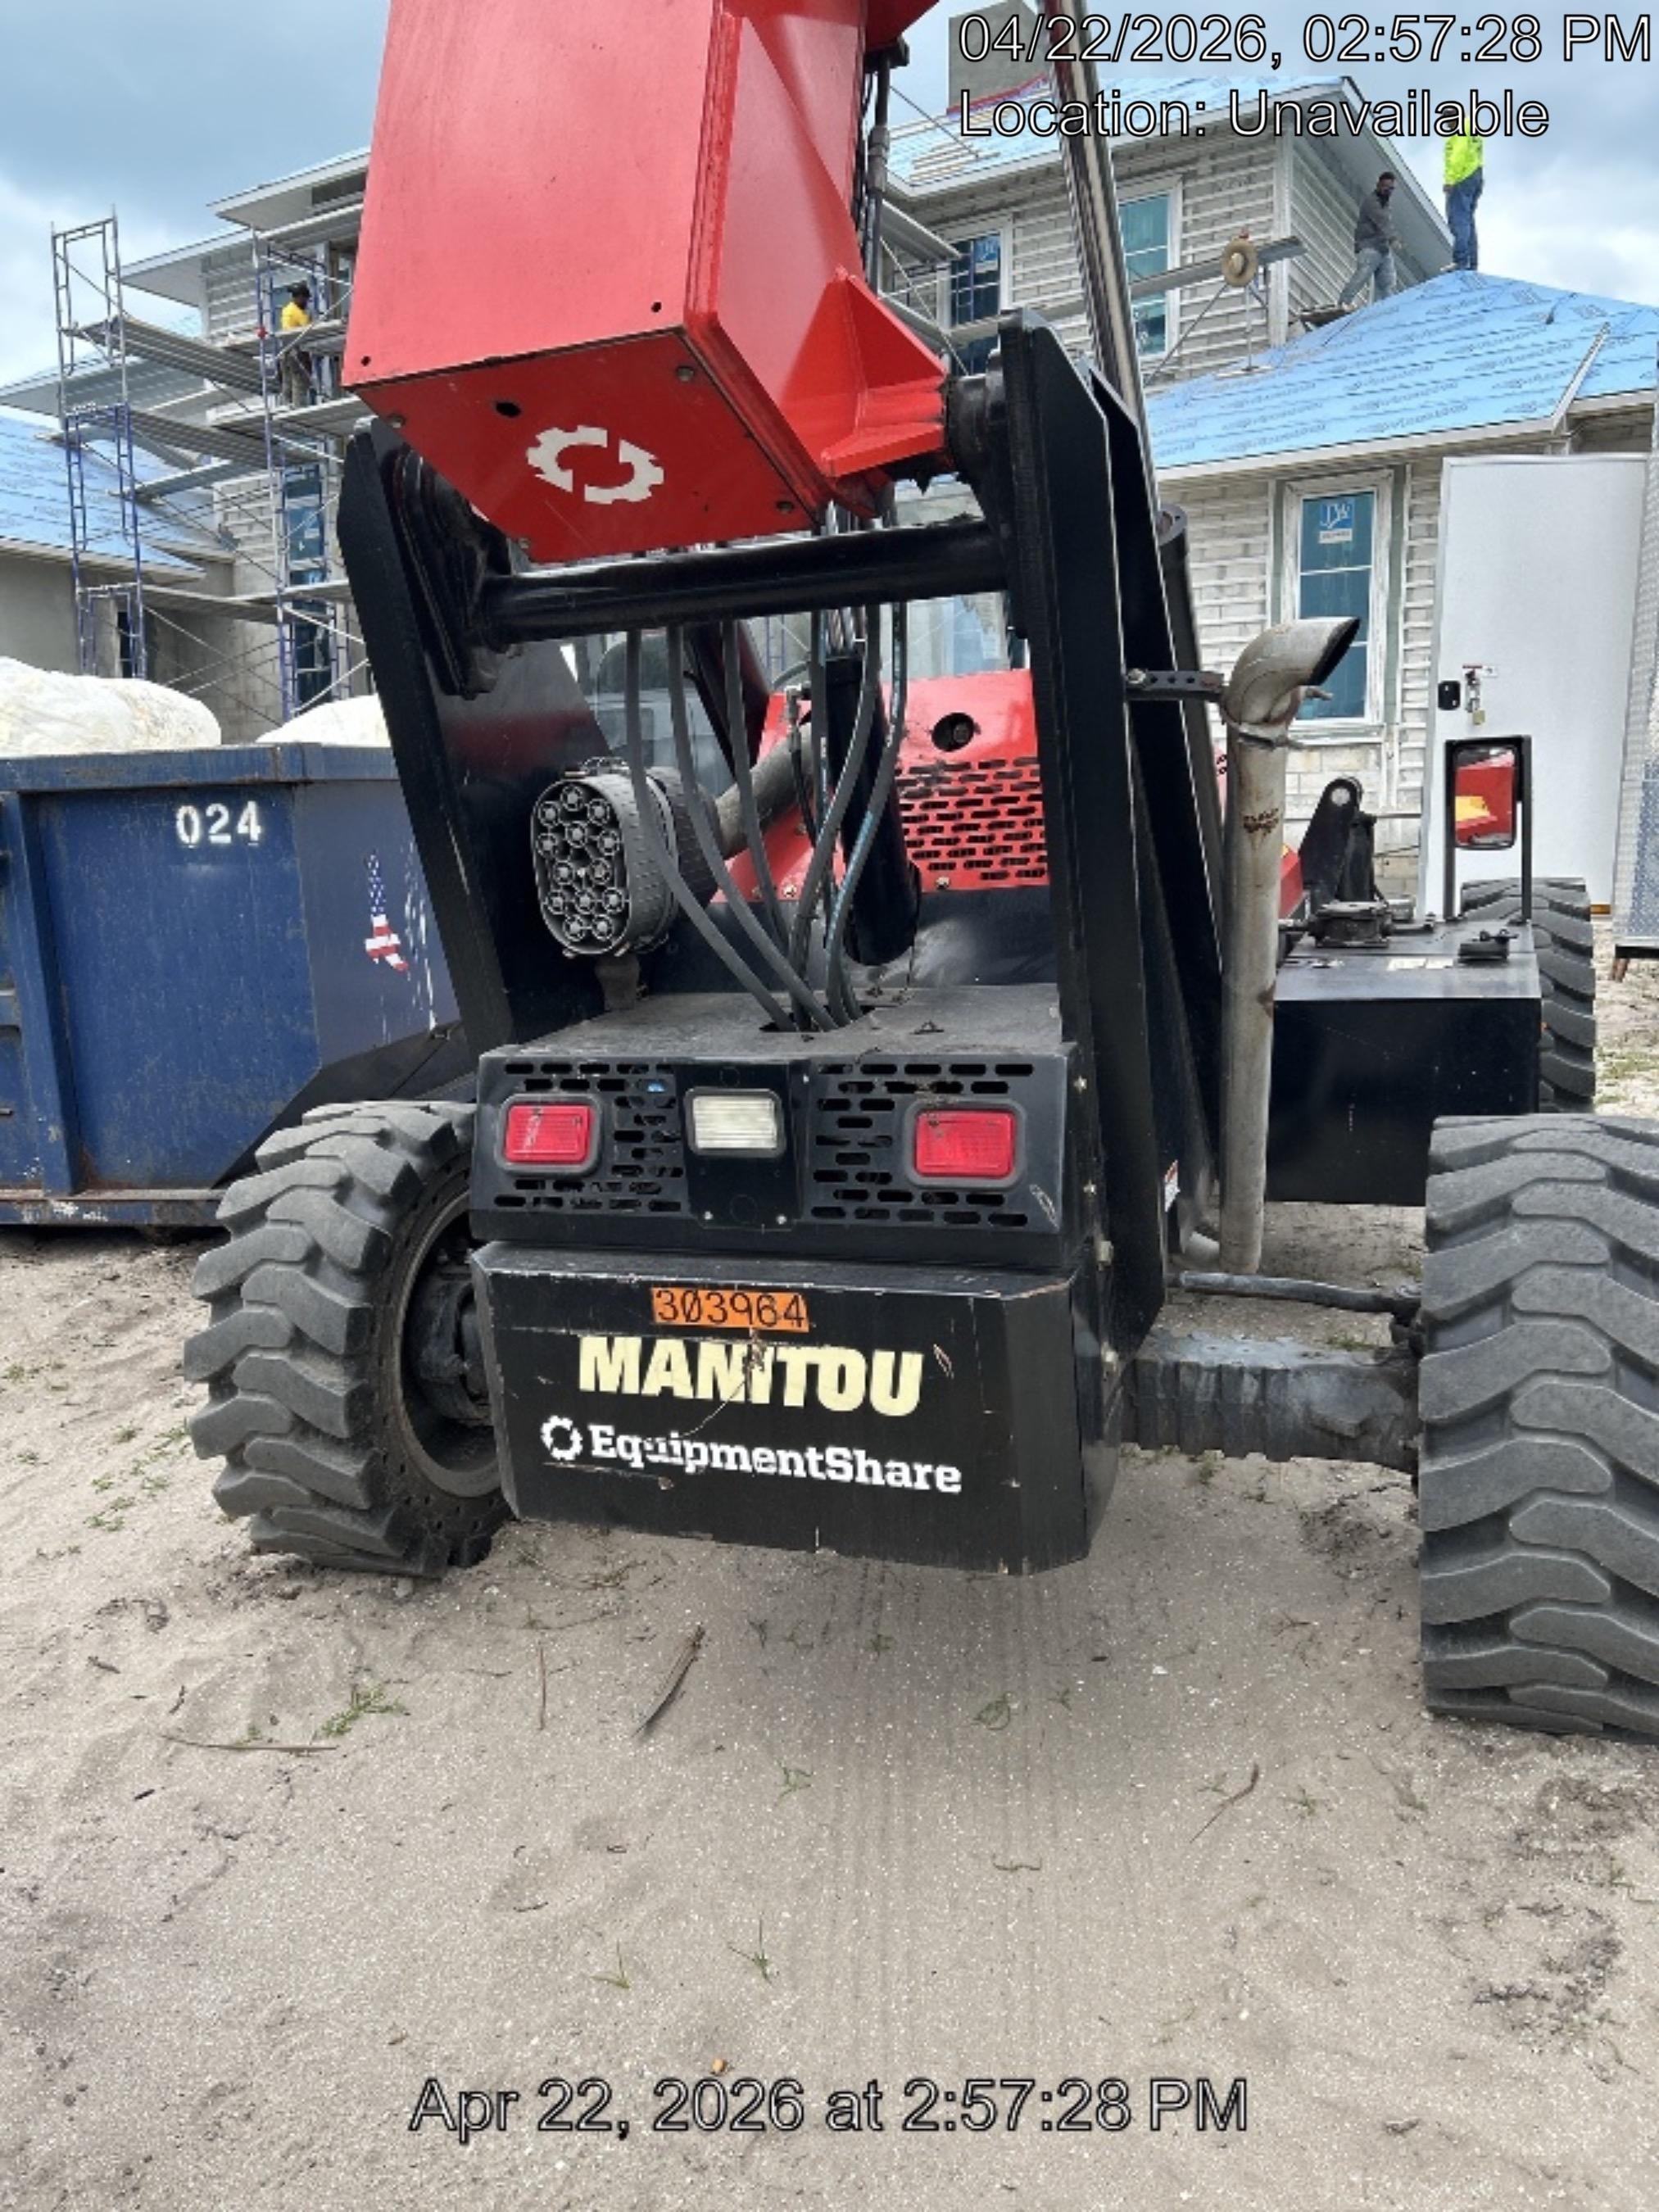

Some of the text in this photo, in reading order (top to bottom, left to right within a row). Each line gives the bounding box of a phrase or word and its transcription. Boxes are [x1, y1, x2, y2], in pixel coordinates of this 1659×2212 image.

[175, 800, 262, 849] 024
[656, 1289, 805, 1328] 303964
[578, 1335, 924, 1417] MANITOU
[587, 1423, 963, 1494] EquipmentShare
